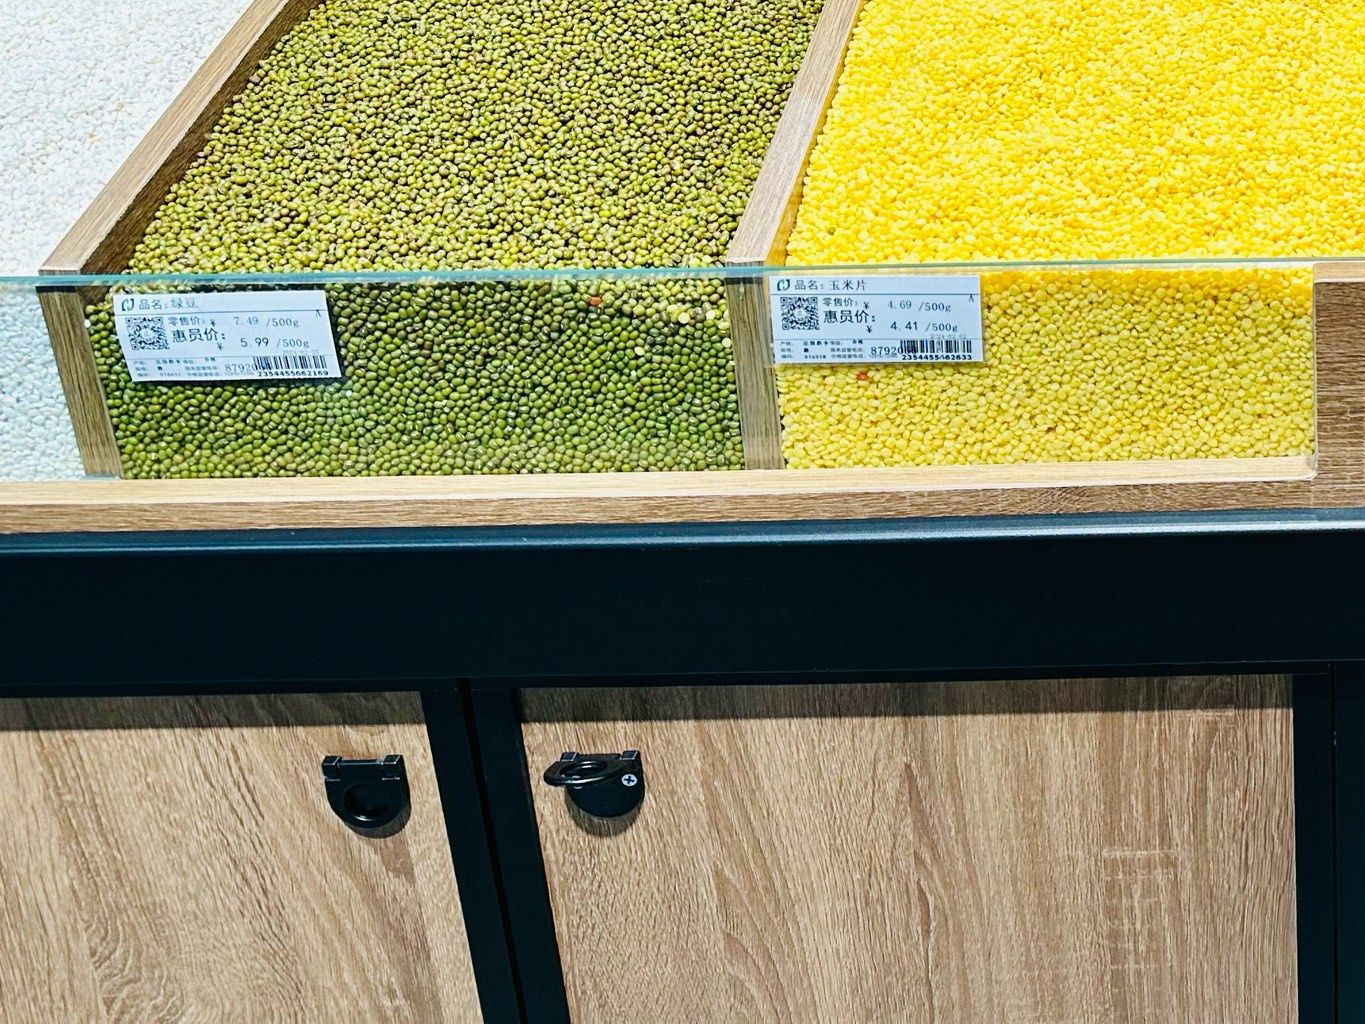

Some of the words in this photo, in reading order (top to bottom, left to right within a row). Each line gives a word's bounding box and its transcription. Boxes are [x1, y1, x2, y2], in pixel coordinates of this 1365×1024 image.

[918, 302, 951, 312] /500g
[266, 318, 299, 328] /500g
[926, 322, 958, 332] /500g
[276, 338, 309, 348] /500g
